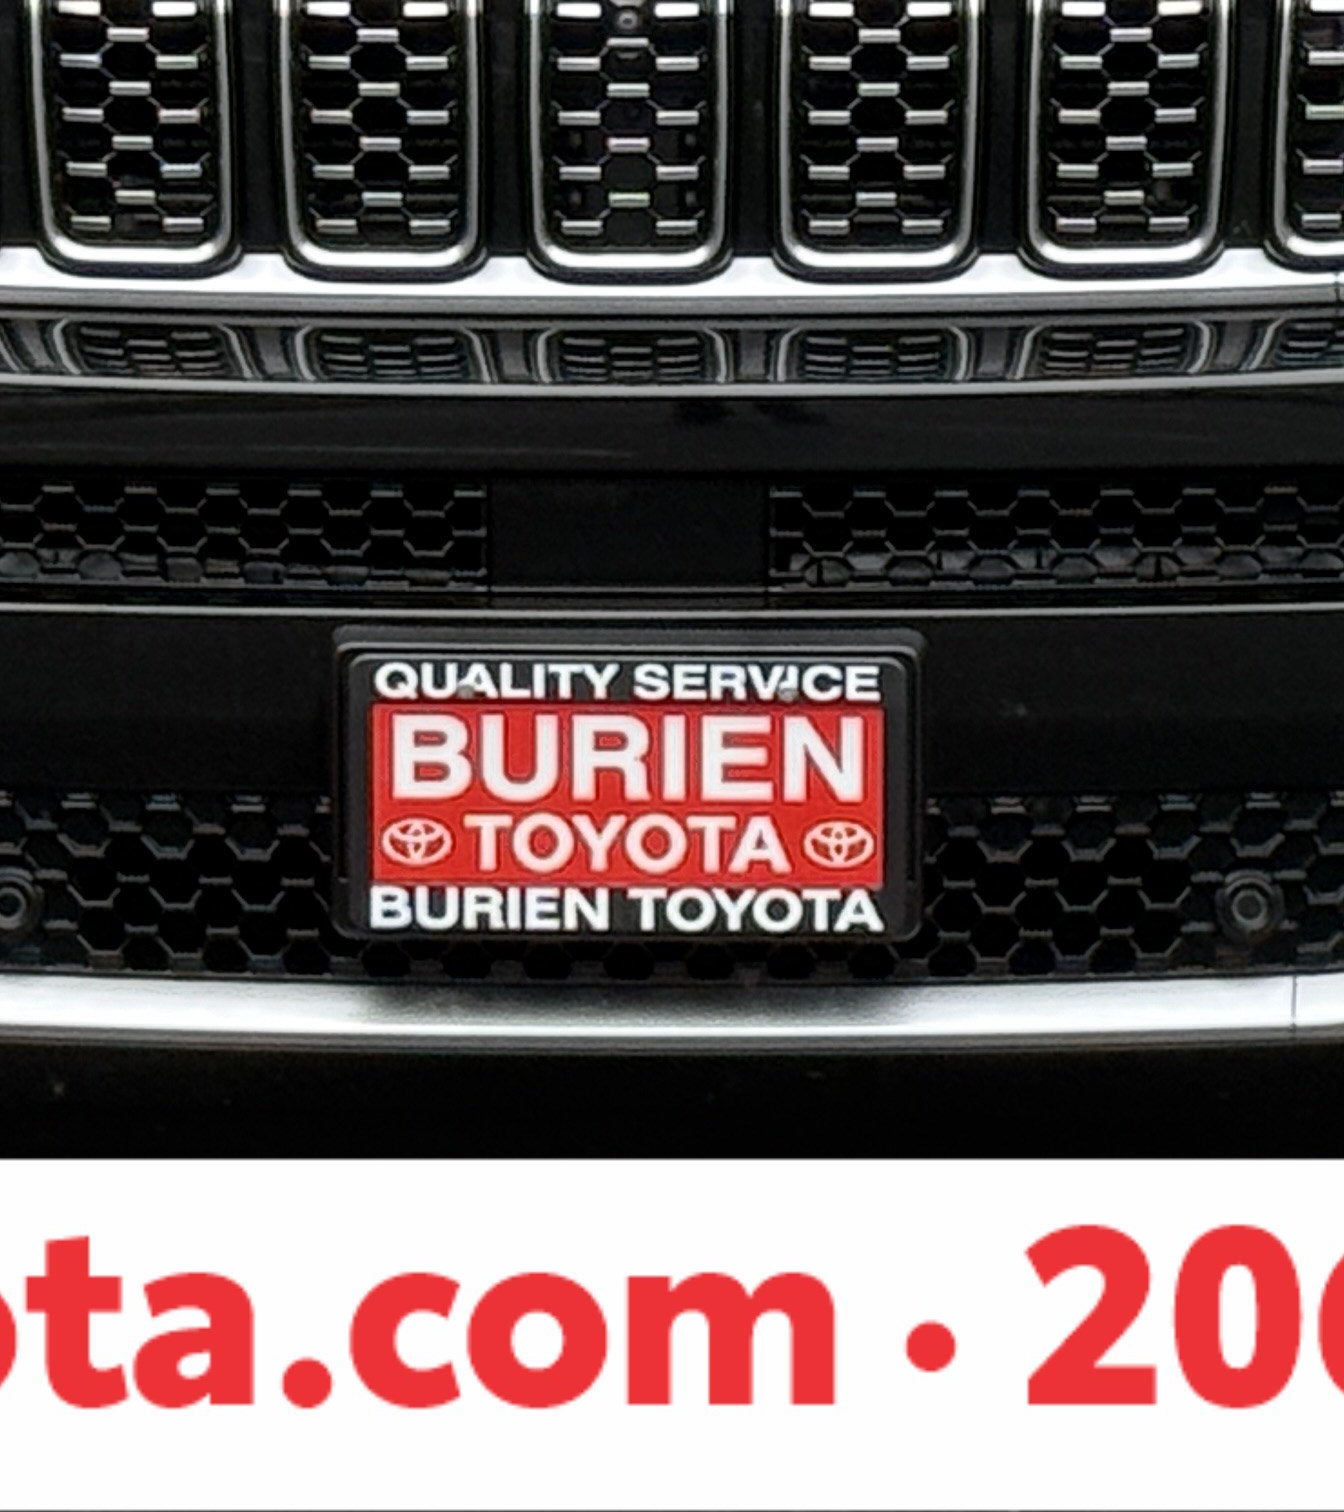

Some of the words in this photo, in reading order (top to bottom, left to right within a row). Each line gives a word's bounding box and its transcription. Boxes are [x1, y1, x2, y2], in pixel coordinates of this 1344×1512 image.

[374, 662, 619, 700] QUALITY
[633, 664, 881, 702] SERVICE
[391, 712, 864, 803] BURIEN
[463, 813, 791, 874] TOYOTA
[370, 888, 610, 931] BURIEN
[628, 888, 885, 932] TOYOTA
